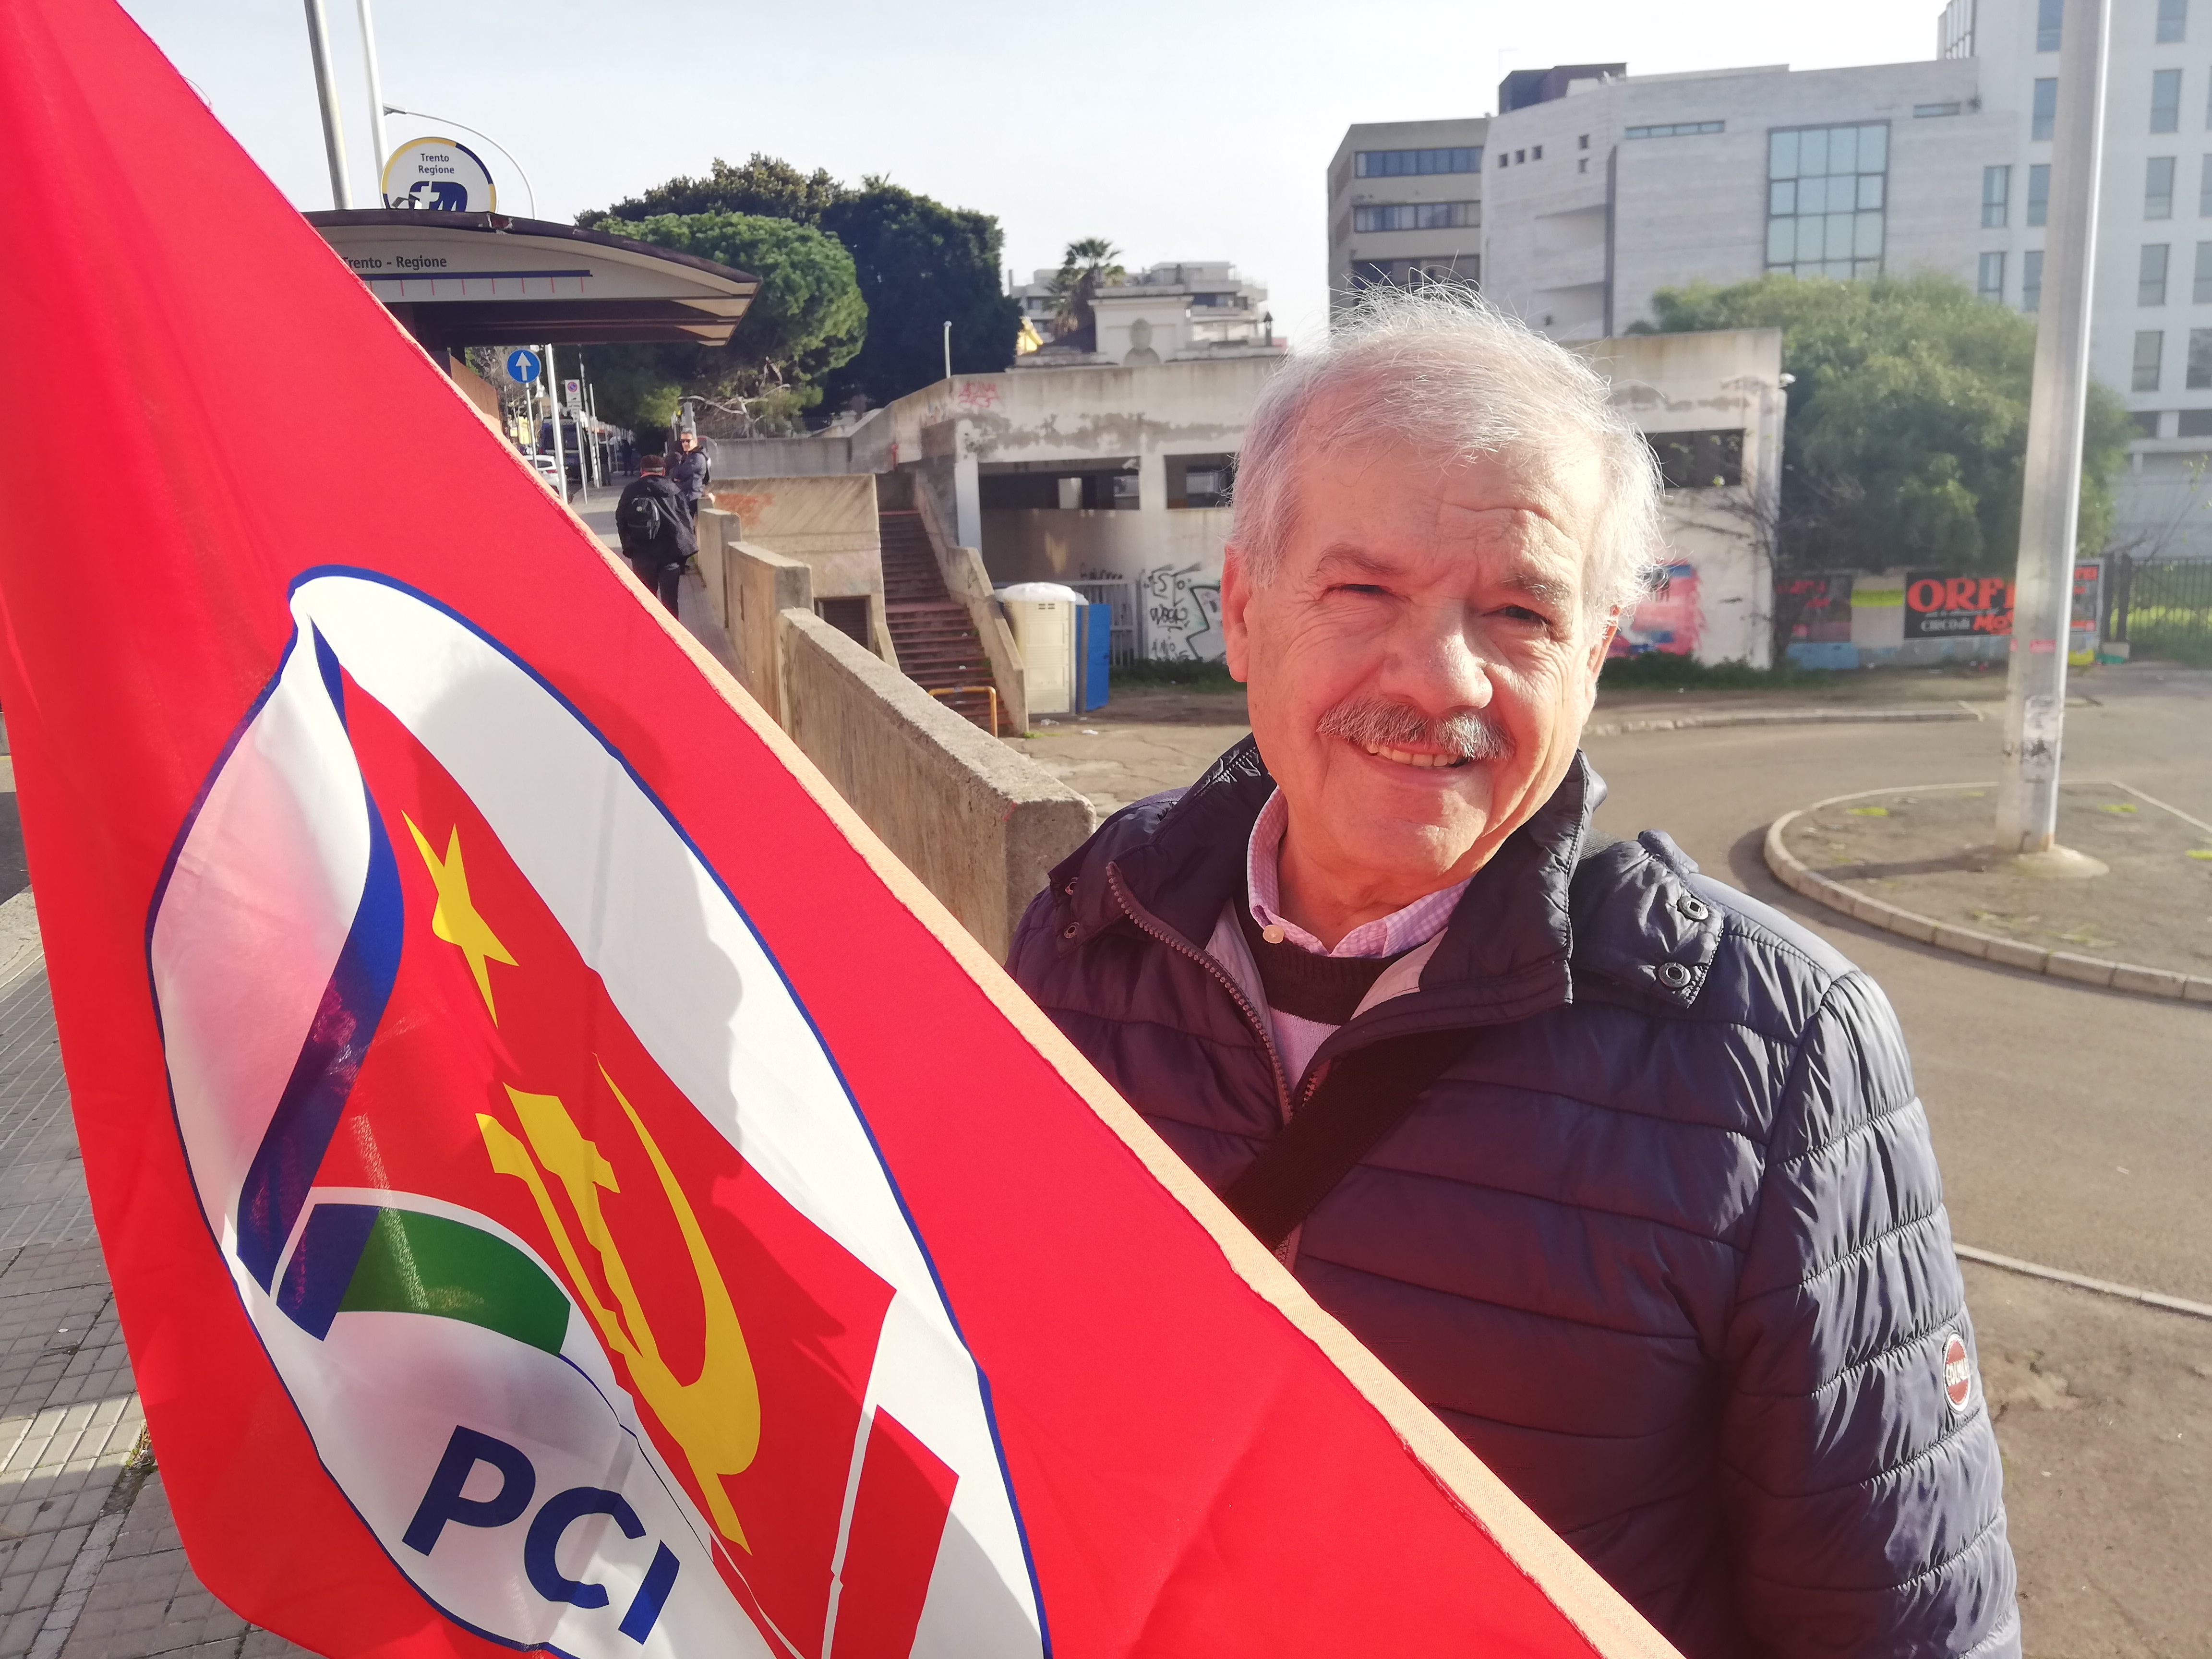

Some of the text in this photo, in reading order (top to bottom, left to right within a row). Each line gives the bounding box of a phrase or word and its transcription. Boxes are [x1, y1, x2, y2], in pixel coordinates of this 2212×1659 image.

[421, 153, 449, 162] Trento
[418, 165, 455, 176] Regione
[396, 254, 447, 271] Regione
[402, 1425, 680, 1645] PCI
